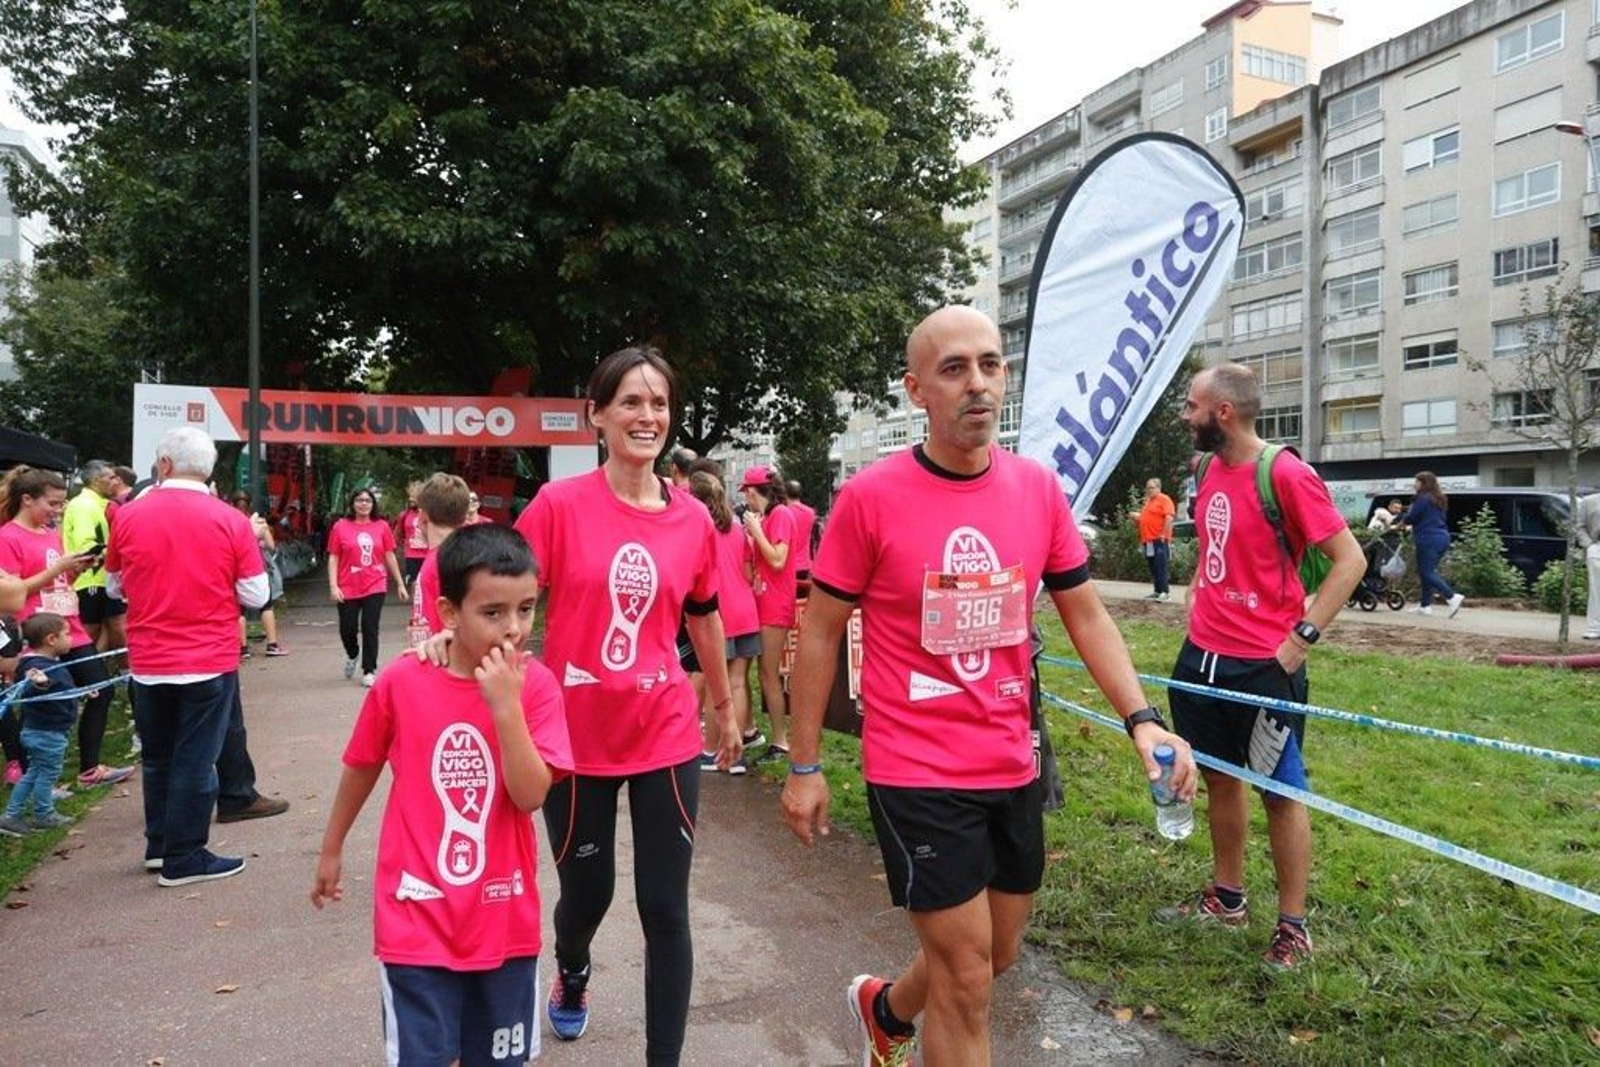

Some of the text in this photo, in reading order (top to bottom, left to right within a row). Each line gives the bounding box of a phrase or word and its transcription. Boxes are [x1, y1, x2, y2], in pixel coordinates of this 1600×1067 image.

[1050, 200, 1220, 502] tlántico
[958, 536, 977, 552] VI
[626, 550, 642, 564] VI
[952, 560, 991, 574] VIGO
[618, 569, 650, 583] VIGO
[956, 596, 1003, 631] 396
[451, 733, 471, 749] VI
[441, 758, 484, 771] VIGO
[440, 769, 487, 779] CONTRA EL
[442, 778, 487, 789] CÁNCER
[491, 1022, 525, 1060] 89
